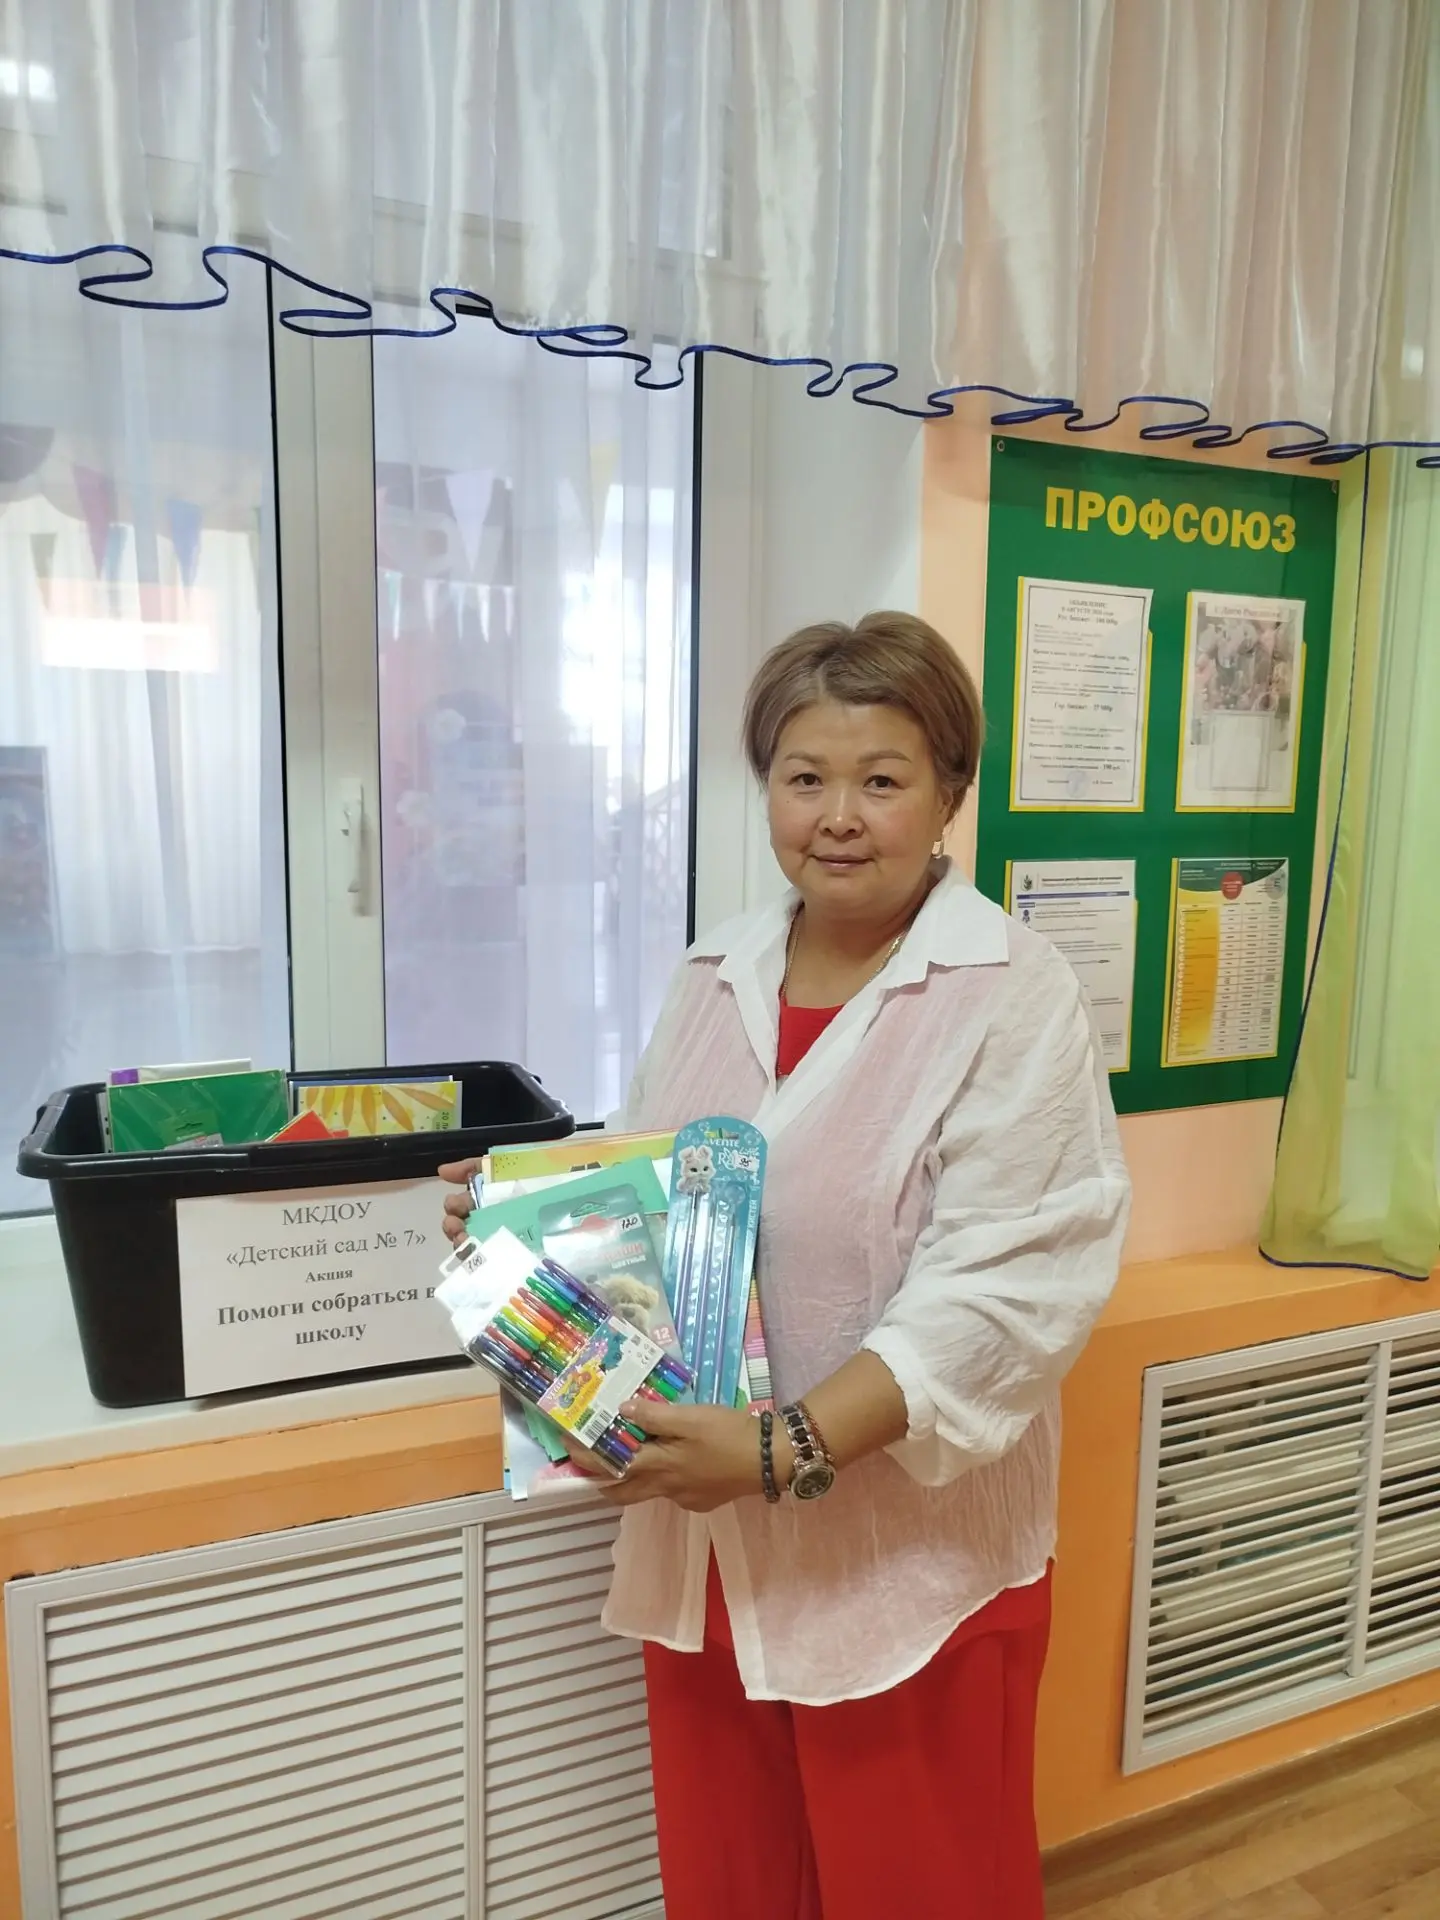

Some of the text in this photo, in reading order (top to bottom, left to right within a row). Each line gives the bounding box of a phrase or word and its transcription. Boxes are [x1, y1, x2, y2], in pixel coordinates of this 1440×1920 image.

[1045, 486, 1296, 553] ПРОФСОЮЗ
[282, 1201, 372, 1226] МКДОУ
[622, 1216, 639, 1230] 120
[226, 1230, 426, 1267] «Детский сад № 7»
[305, 1269, 353, 1283] Акция
[217, 1301, 304, 1325] Помоги
[311, 1290, 419, 1314] собраться
[295, 1323, 367, 1345] школу
[653, 1326, 670, 1341] 12
